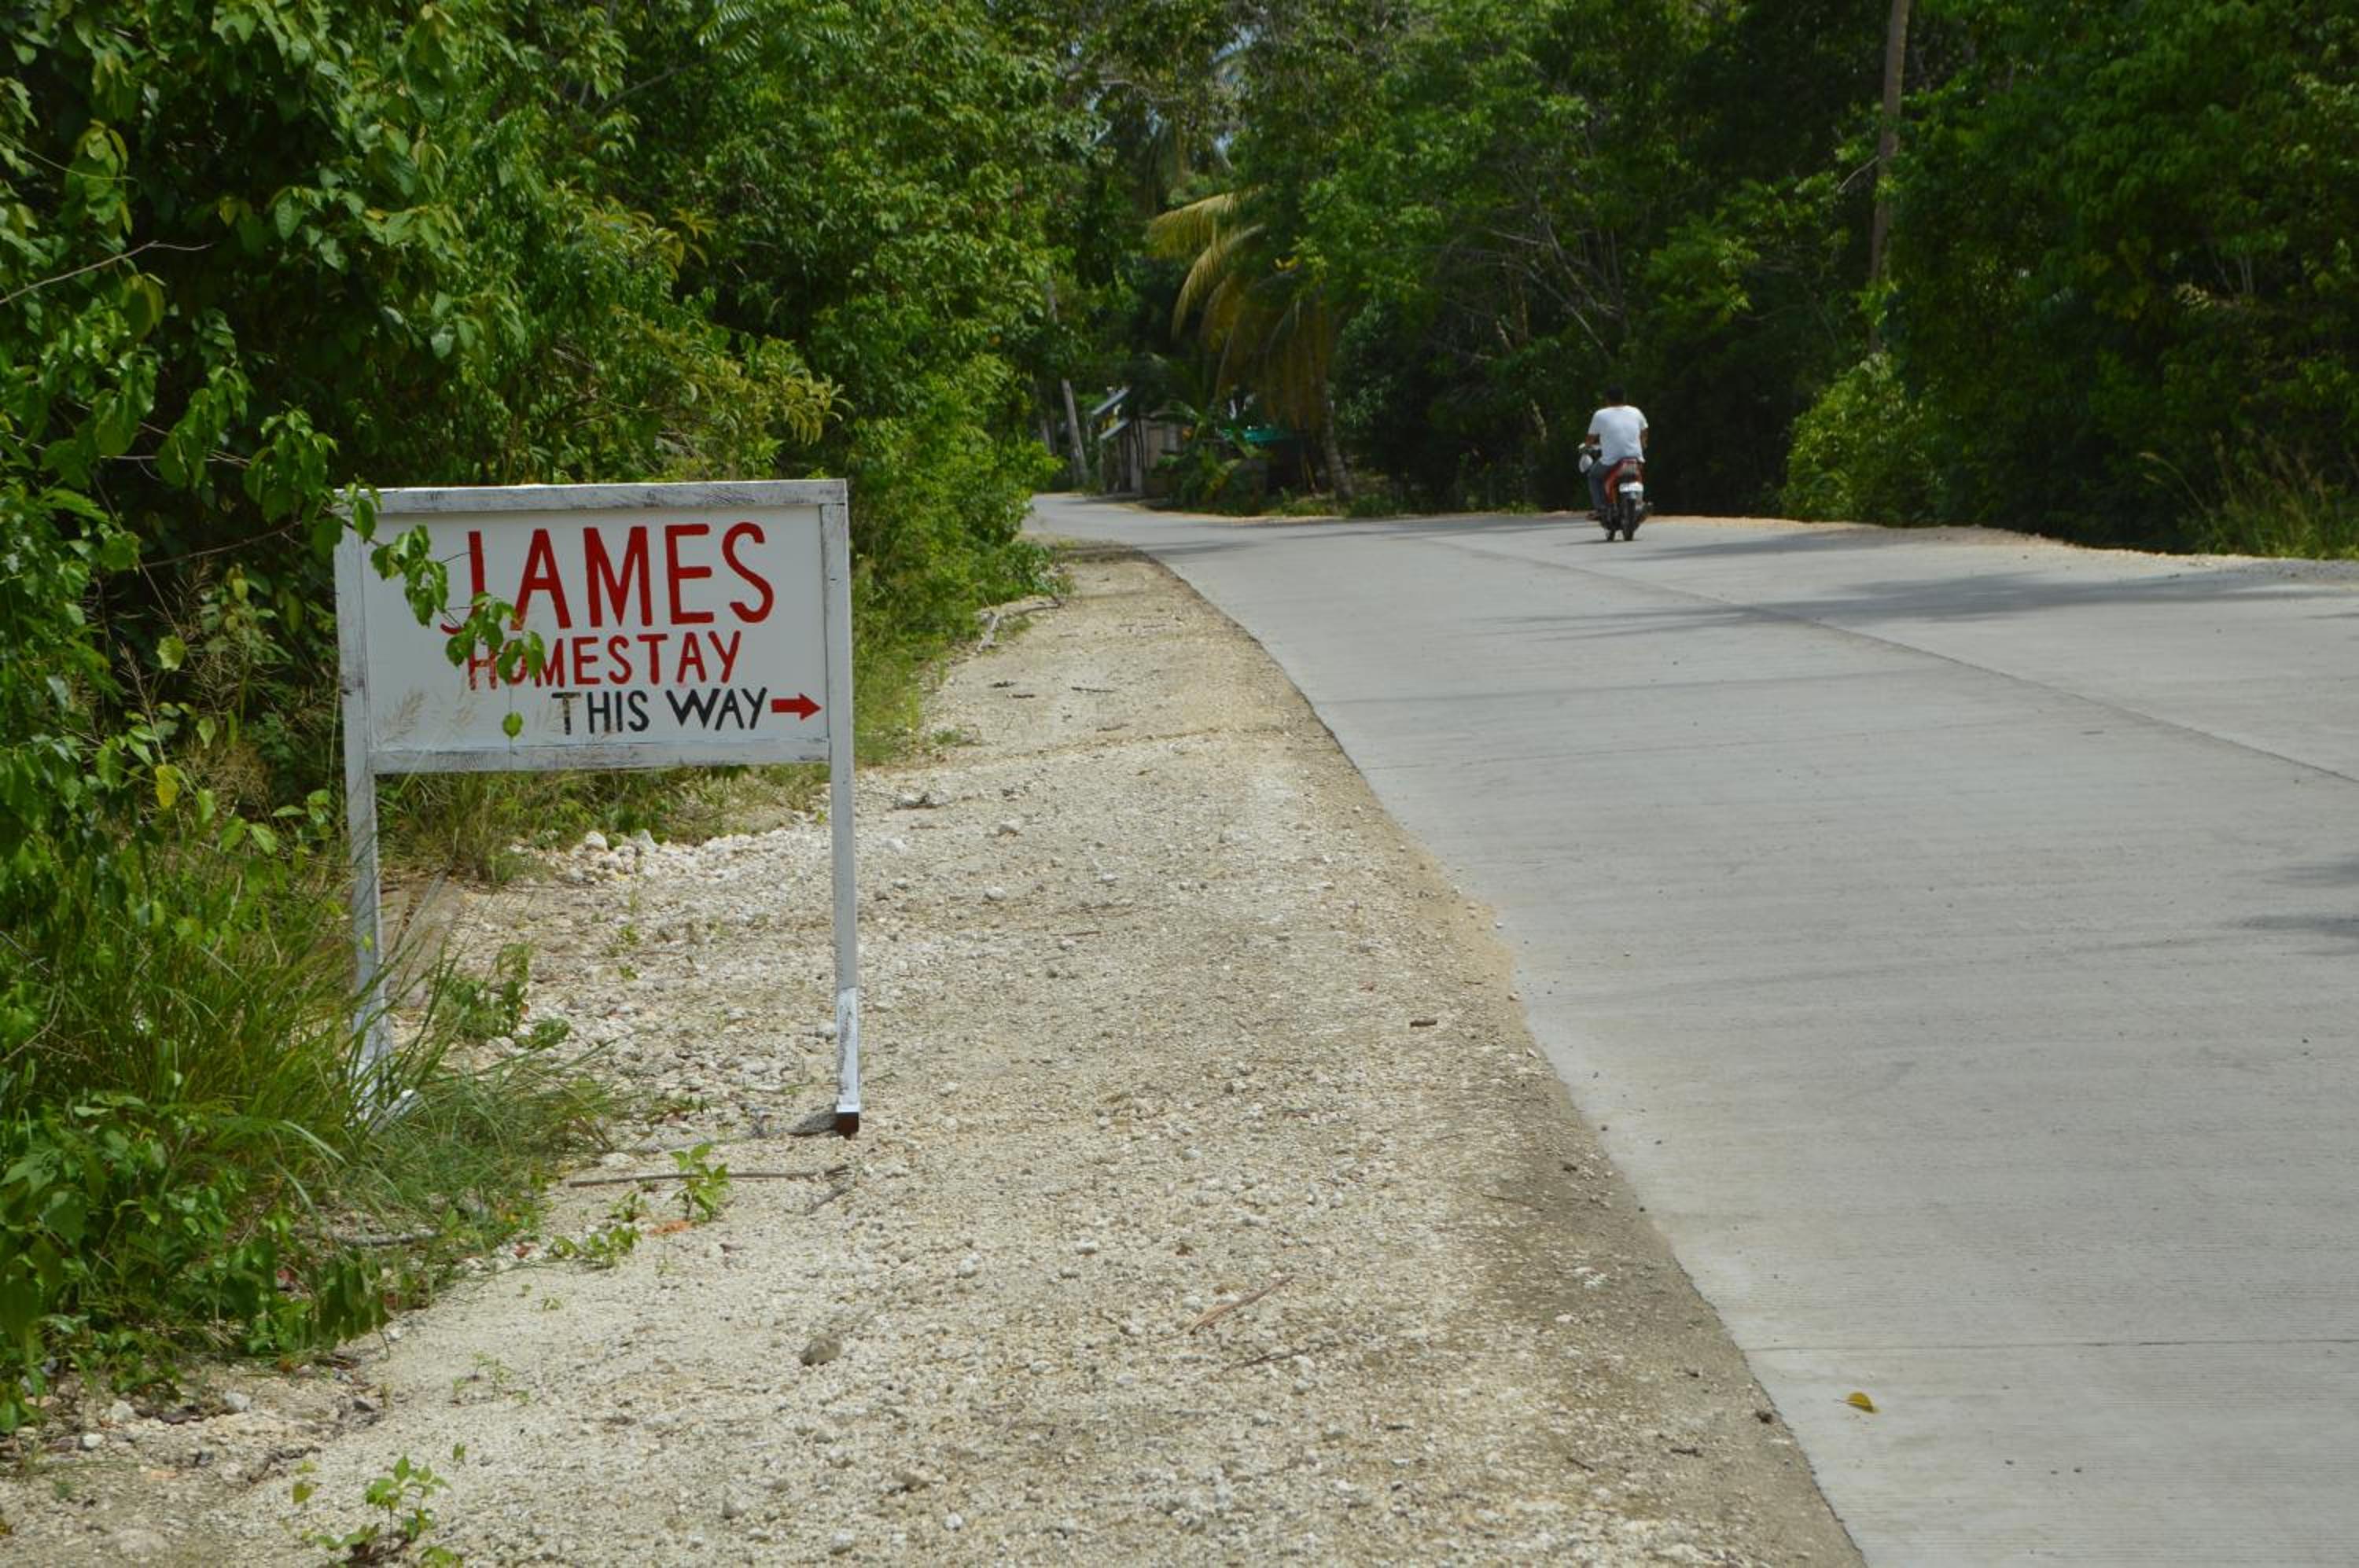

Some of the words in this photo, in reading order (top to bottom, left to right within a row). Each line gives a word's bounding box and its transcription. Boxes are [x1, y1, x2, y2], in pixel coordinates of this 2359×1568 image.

[440, 522, 774, 635] JAMES
[551, 690, 650, 734] THIS
[665, 686, 767, 731] WAY
